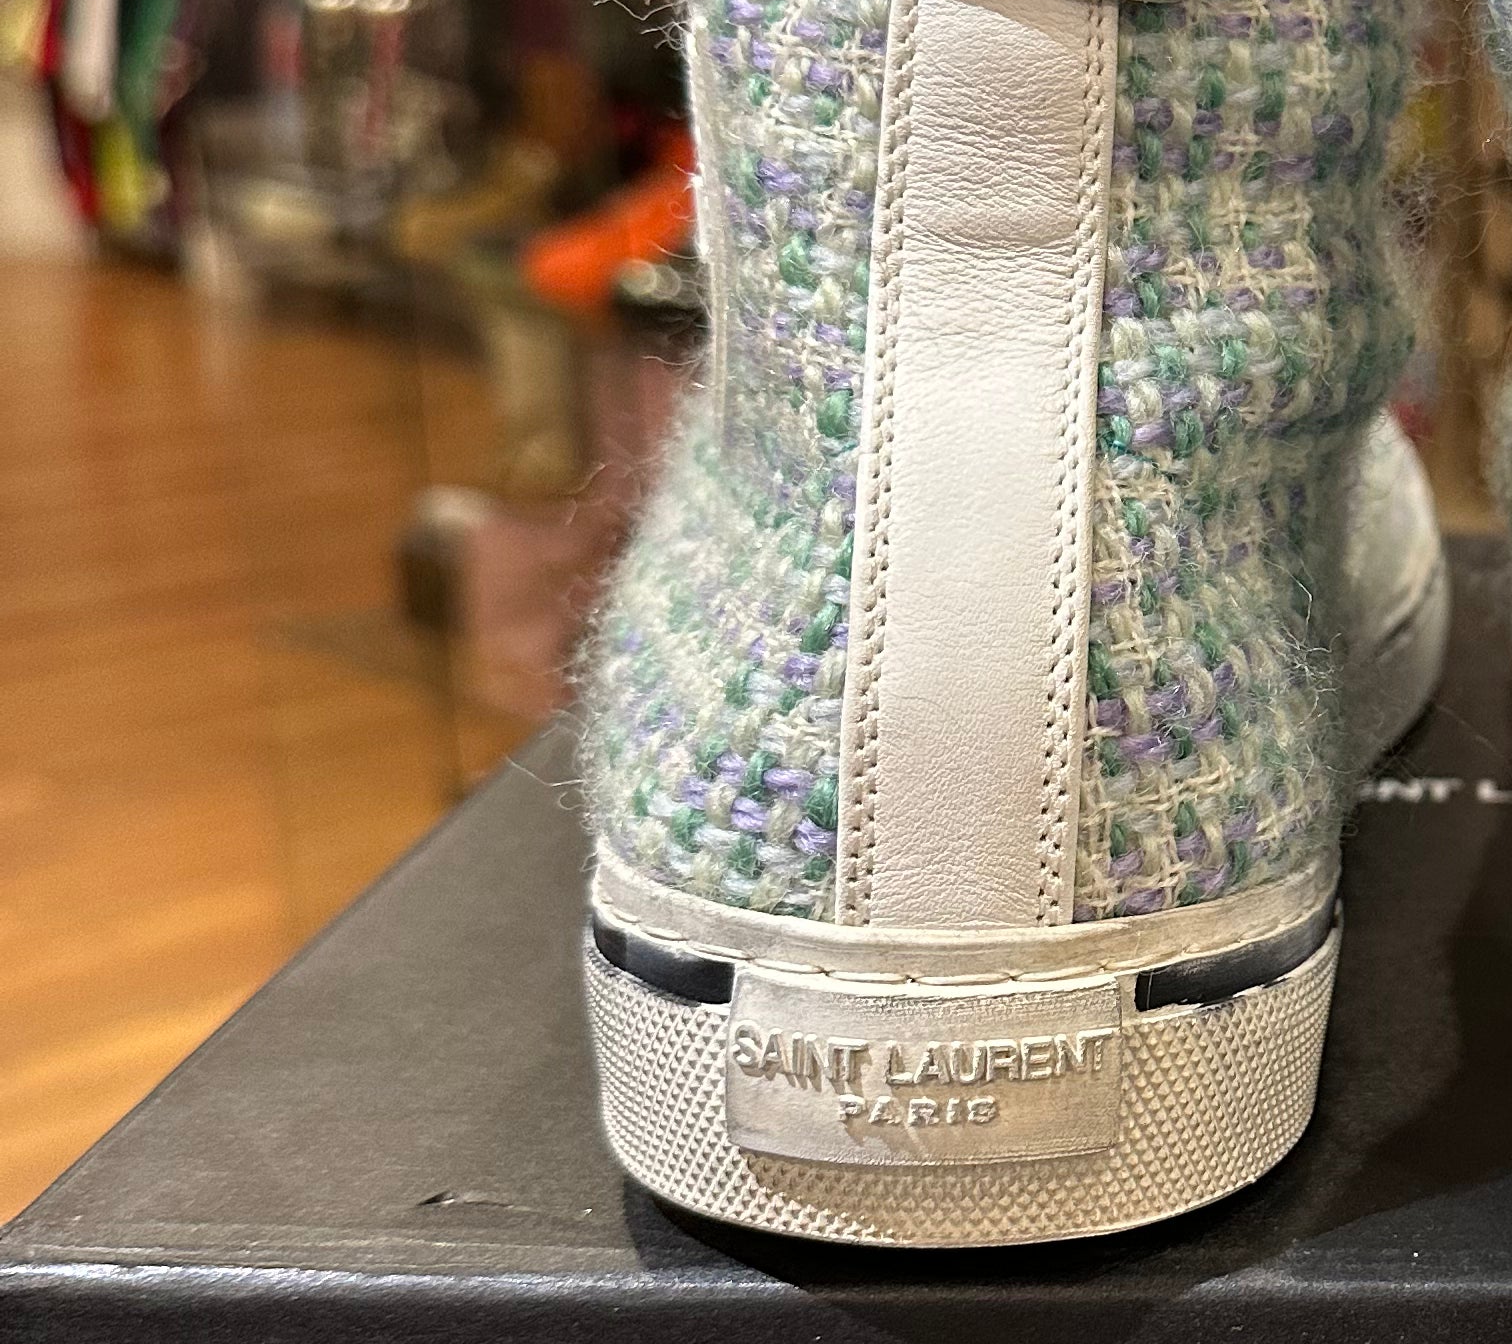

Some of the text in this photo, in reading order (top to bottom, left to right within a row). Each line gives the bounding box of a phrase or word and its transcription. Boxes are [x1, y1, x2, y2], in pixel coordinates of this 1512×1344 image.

[732, 1019, 1120, 1085] SAINT LAURENT
[838, 1094, 998, 1128] PARIS
